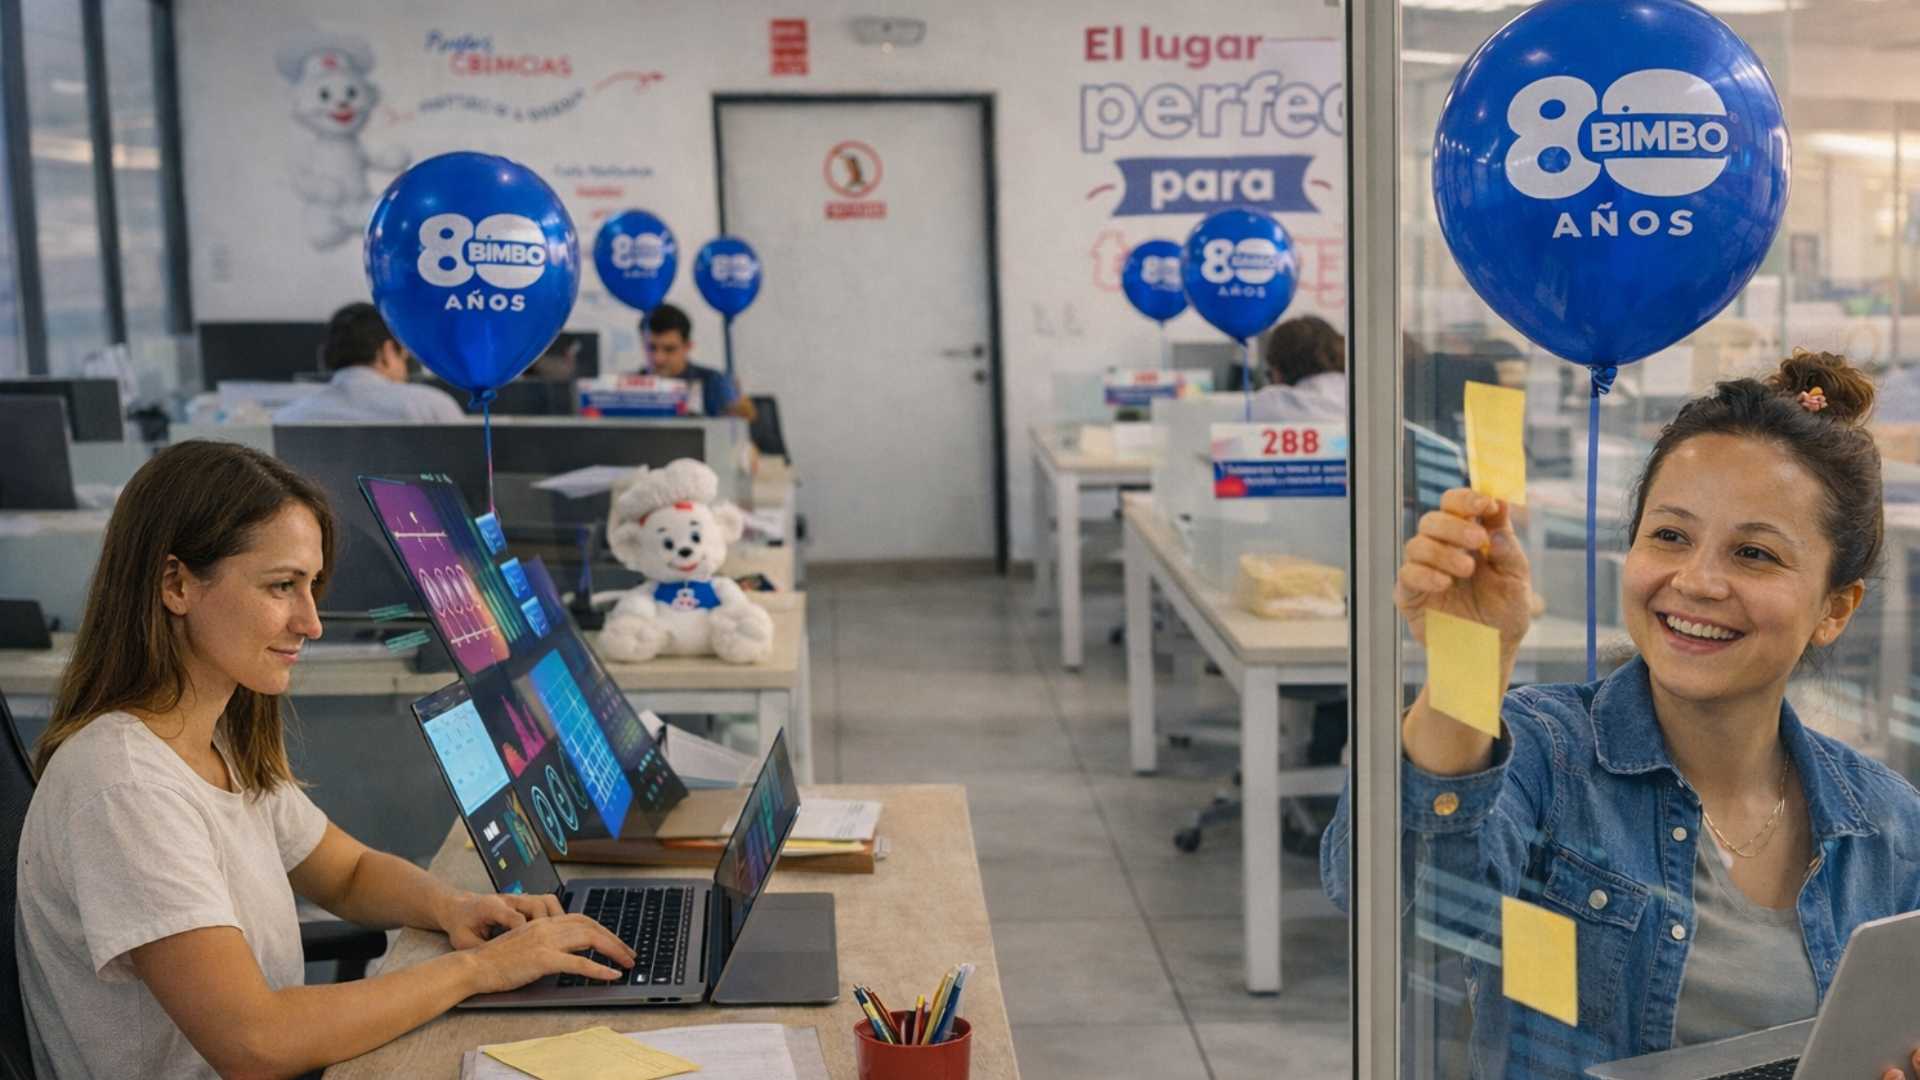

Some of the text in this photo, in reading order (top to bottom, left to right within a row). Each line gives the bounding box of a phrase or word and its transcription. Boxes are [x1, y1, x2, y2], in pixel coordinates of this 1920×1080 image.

[1085, 26, 1264, 70] El lugar
[1591, 121, 1729, 152] BIMBO
[1151, 168, 1275, 210] para
[1552, 202, 1694, 239] AÑOS
[468, 240, 546, 265] BIMBO
[444, 290, 526, 312] AÑOS
[1261, 429, 1320, 456] 288
